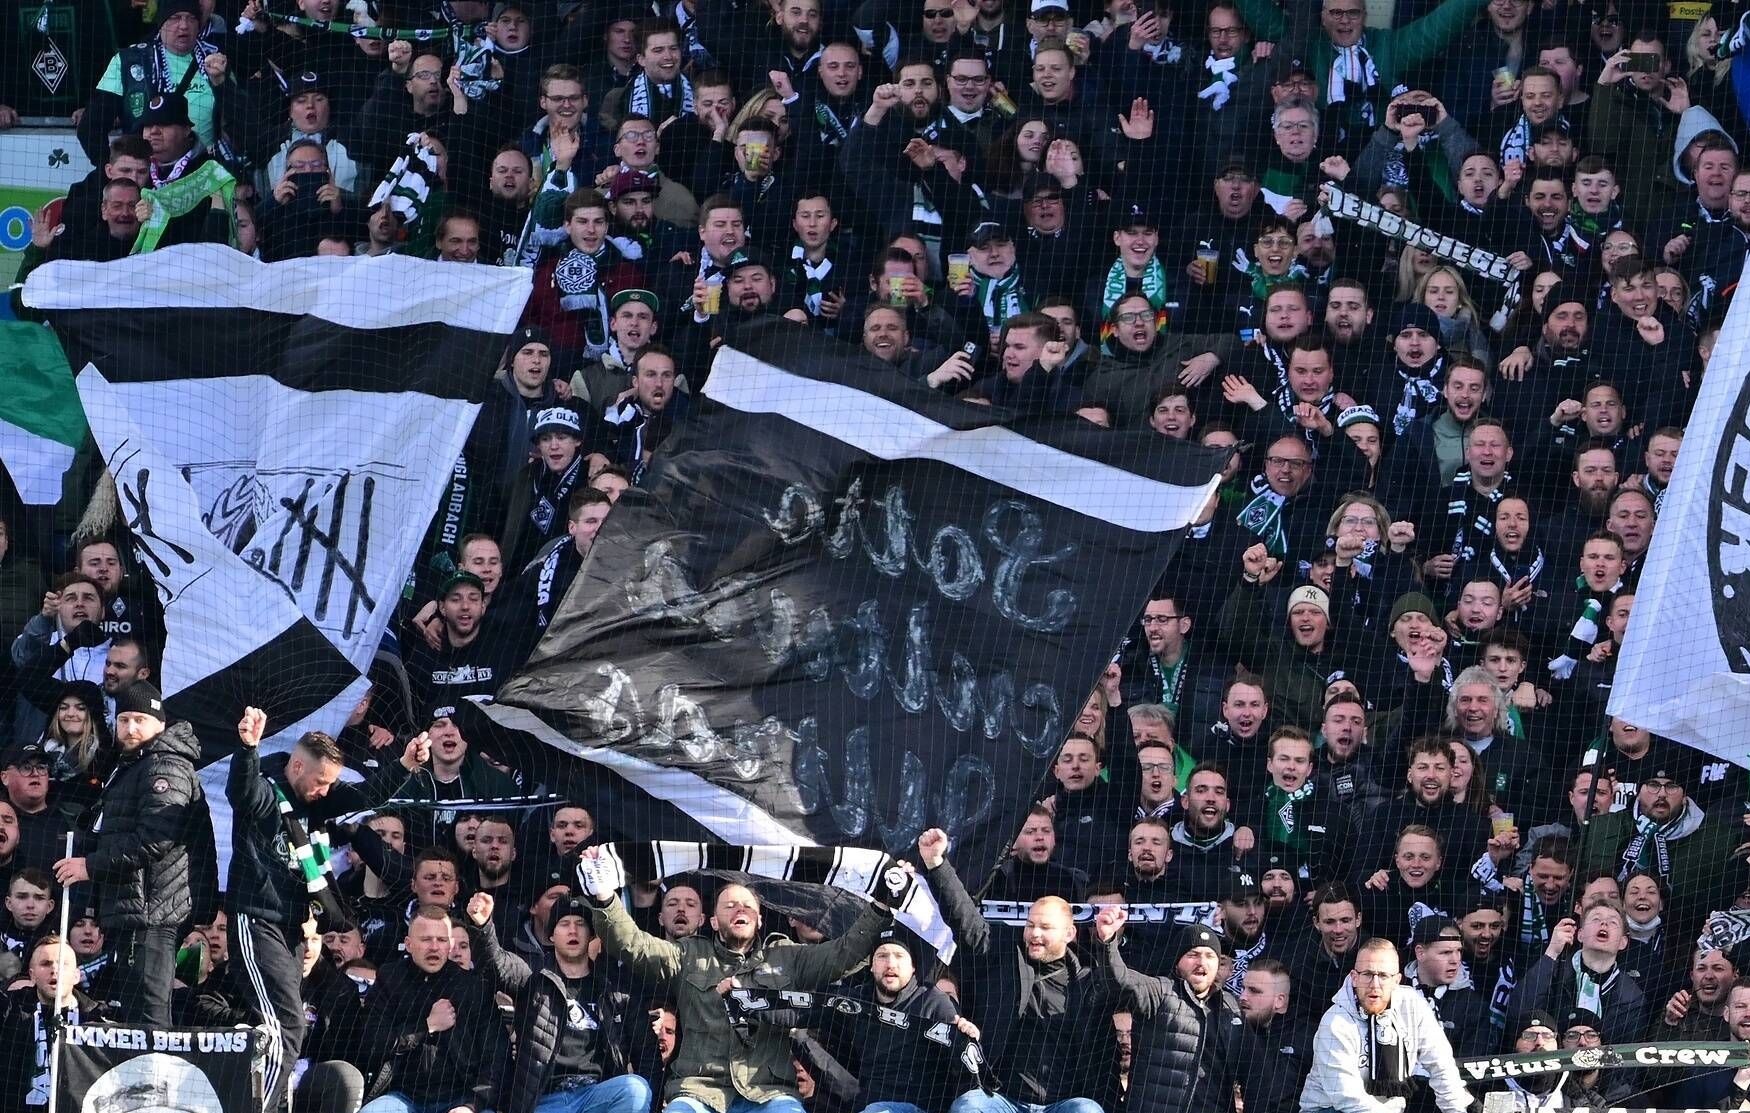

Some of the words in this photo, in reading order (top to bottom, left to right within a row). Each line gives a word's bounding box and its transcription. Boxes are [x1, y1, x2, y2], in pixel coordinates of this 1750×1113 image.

[65, 1025, 148, 1051] IMMER
[152, 1029, 192, 1053] BEI
[197, 1031, 249, 1054] UNS
[1464, 1057, 1563, 1081] Vitus
[1634, 1044, 1731, 1067] Crew
